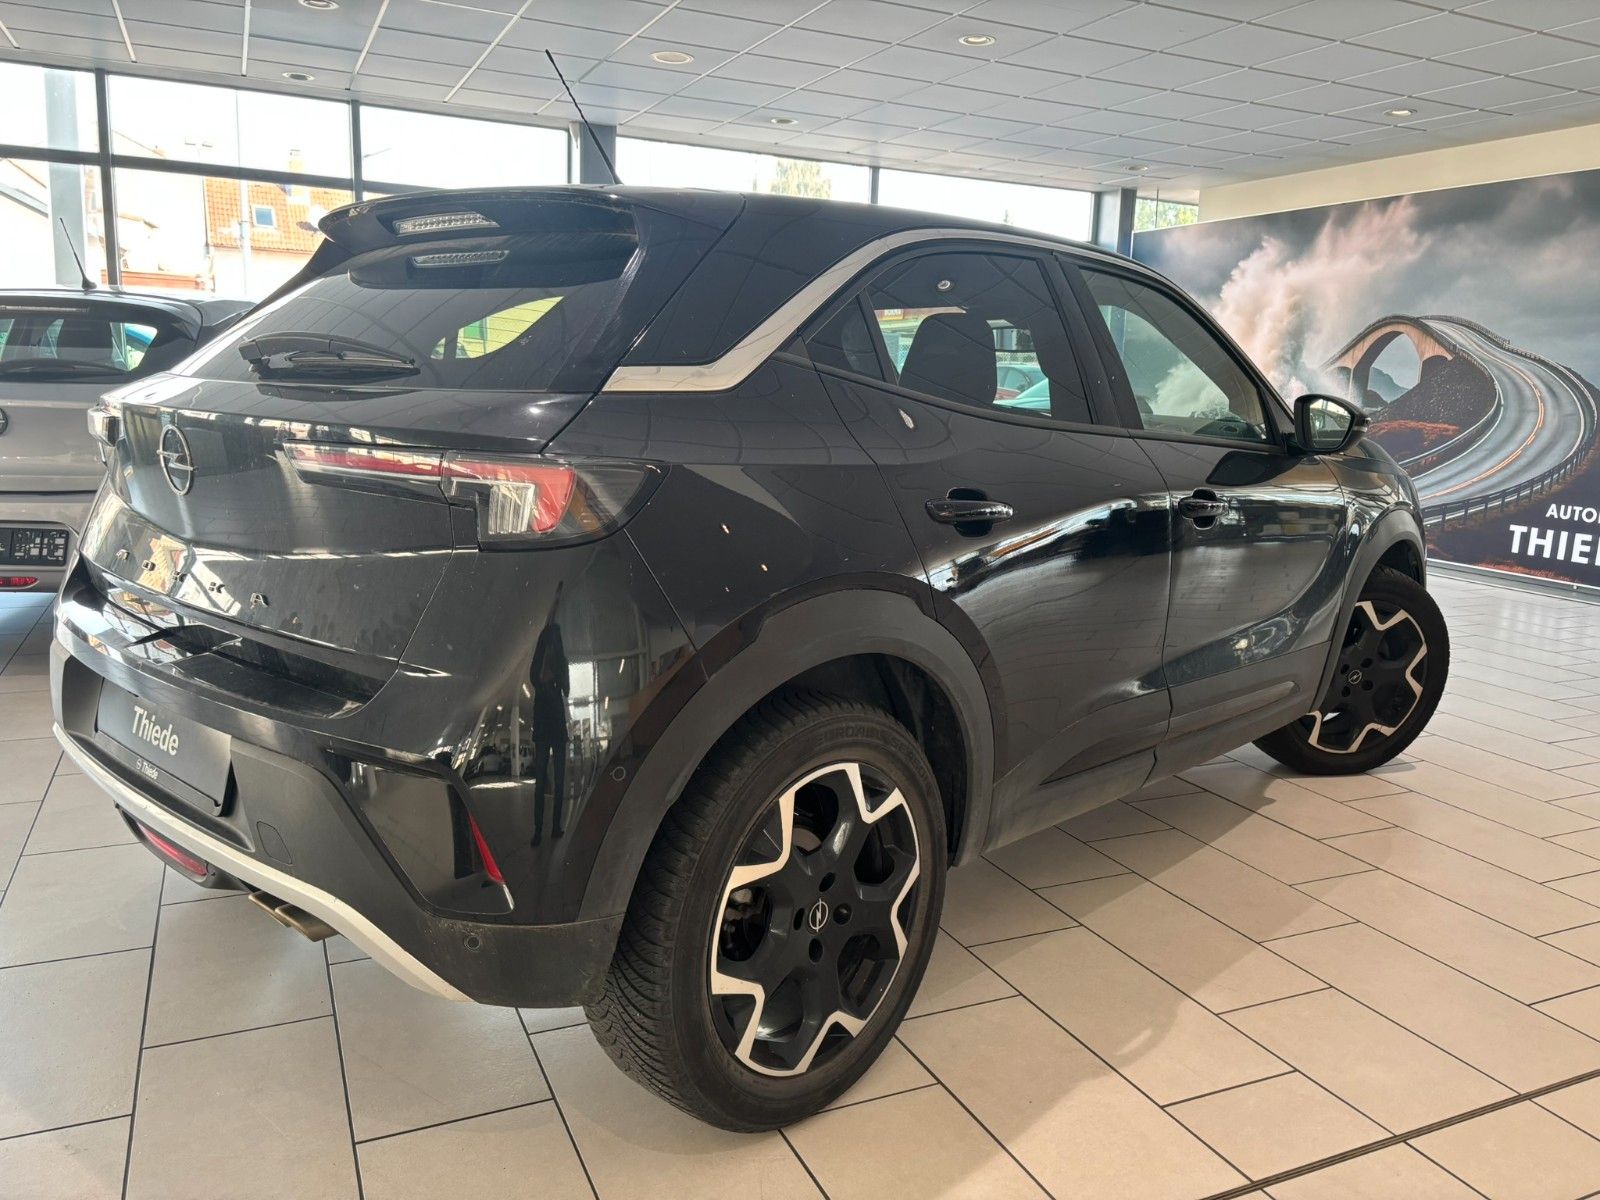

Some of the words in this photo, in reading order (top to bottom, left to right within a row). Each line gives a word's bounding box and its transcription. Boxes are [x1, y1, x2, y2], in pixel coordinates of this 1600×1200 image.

[1545, 503, 1600, 524] AUTO
[1509, 524, 1600, 566] THIE
[132, 705, 179, 756] Thiede
